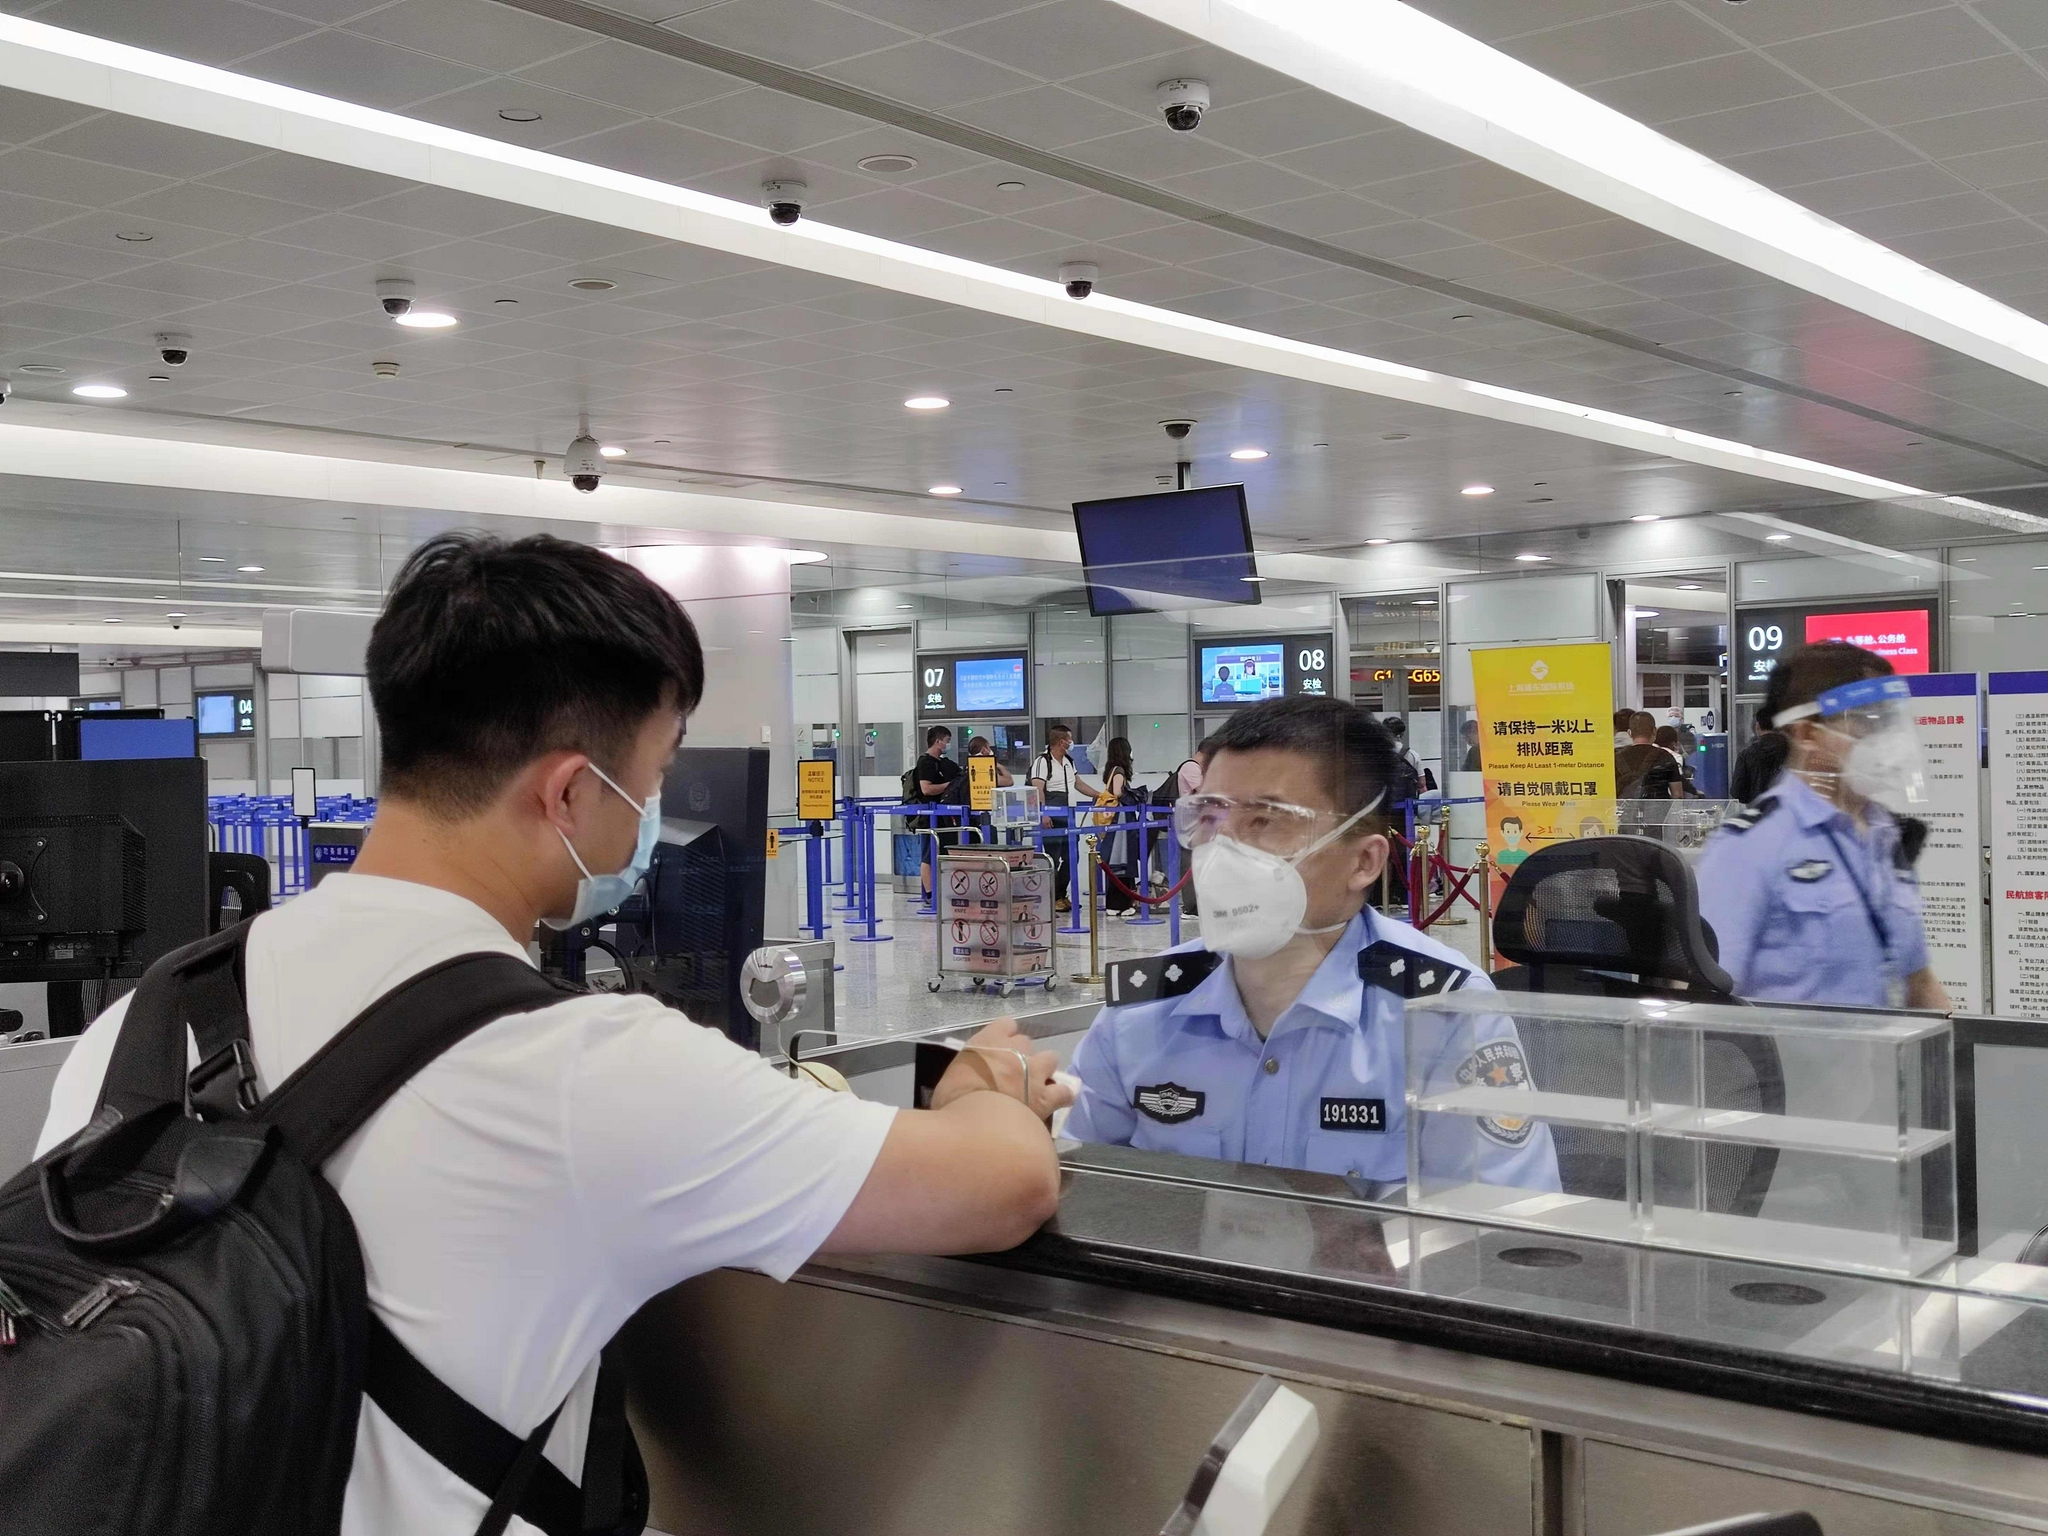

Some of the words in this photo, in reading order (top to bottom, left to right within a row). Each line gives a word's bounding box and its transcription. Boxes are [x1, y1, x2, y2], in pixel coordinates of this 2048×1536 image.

[1748, 625, 1783, 651] 09
[1898, 647, 1918, 655] Class
[1299, 649, 1325, 671] 08
[924, 668, 944, 687] 07
[1303, 678, 1322, 690] 安检
[927, 693, 943, 704] 安检
[239, 699, 253, 715] 04
[1494, 718, 1595, 736] 请保持一米以上
[1517, 741, 1574, 757] 排队距离
[1497, 781, 1598, 797] 请自觉佩戴口罩
[1323, 1103, 1380, 1124] 191331
